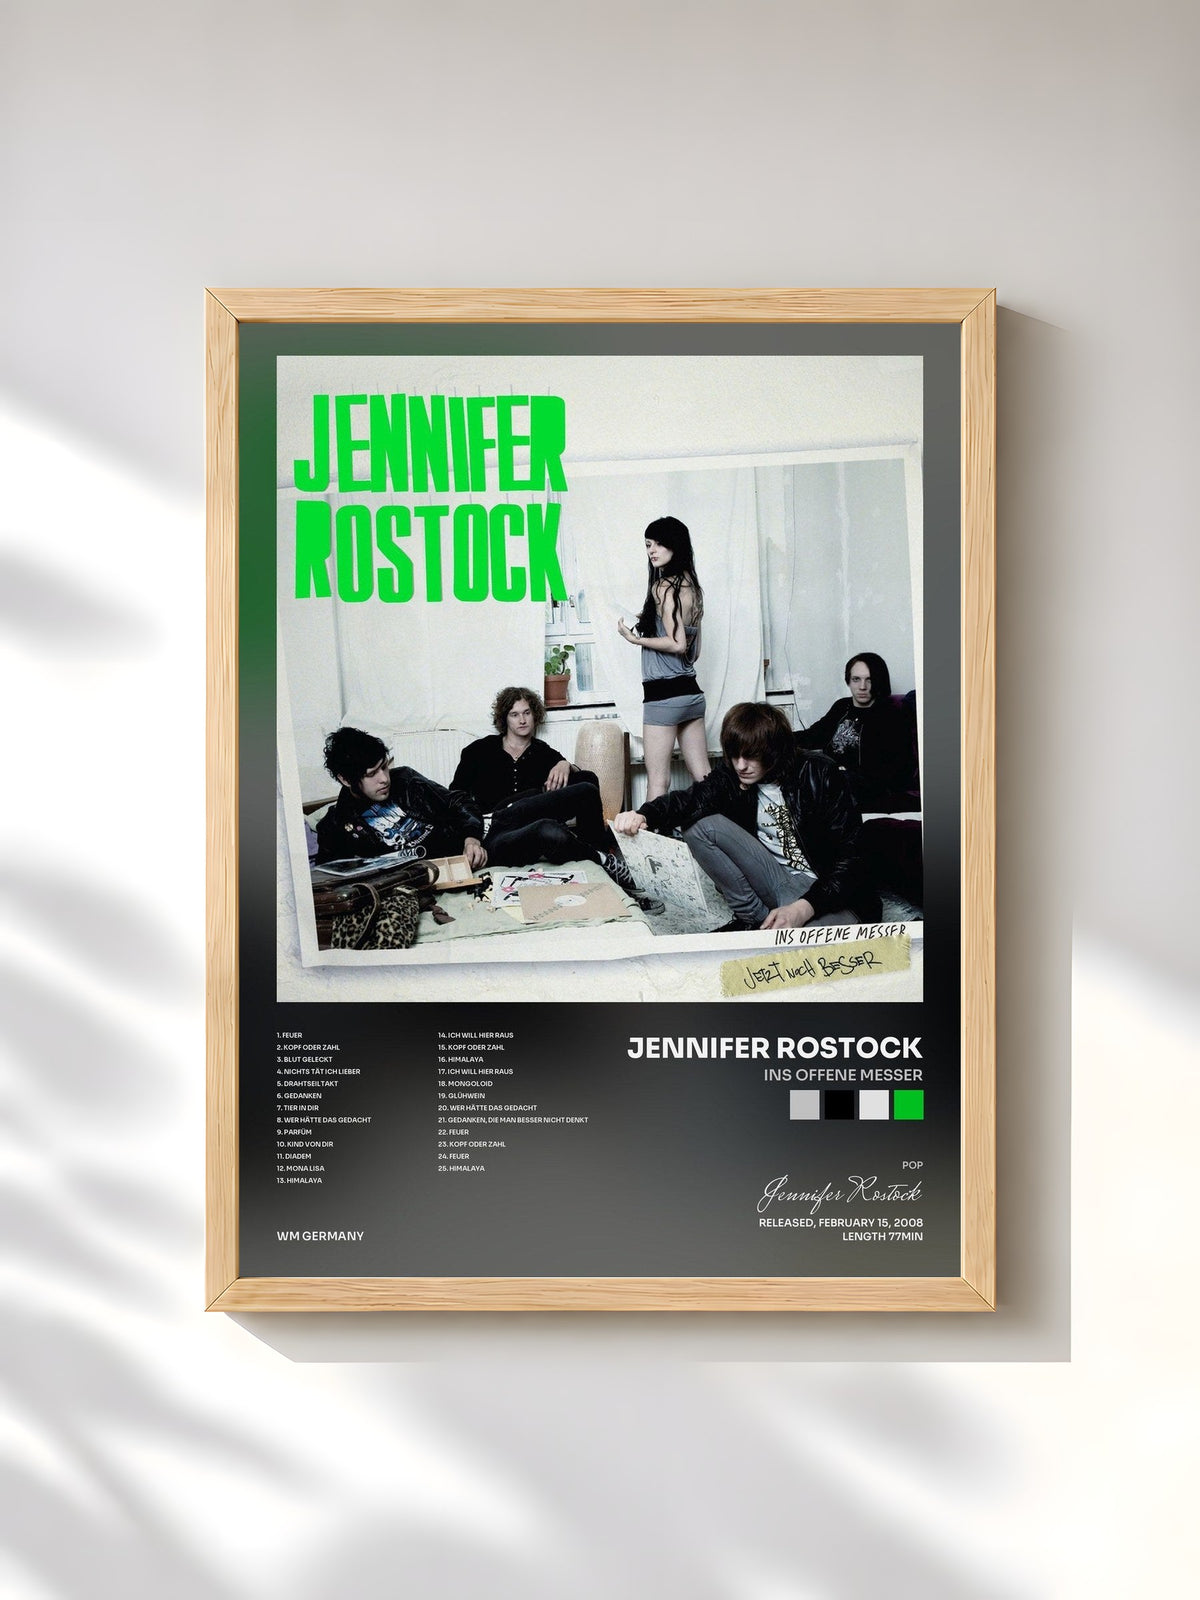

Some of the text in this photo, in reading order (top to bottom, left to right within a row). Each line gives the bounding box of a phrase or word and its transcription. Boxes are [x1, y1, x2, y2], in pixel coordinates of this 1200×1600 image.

[294, 393, 568, 492] JENNIFER
[295, 500, 568, 603] ROSTOCK
[775, 929, 794, 945] INS
[800, 927, 851, 944] OFFENE
[627, 1036, 923, 1059] JENNIFER ROSTOCK
[764, 1068, 923, 1081] INS OFFENE MESSER
[902, 1161, 923, 1170] POP
[756, 1174, 922, 1214] Jennifer Rostock
[759, 1218, 924, 1229] RELEASED, FEBRUARY 15, 2008
[276, 1231, 364, 1241] WM GERMANY
[842, 1232, 923, 1241] LENGTH 77MIN
